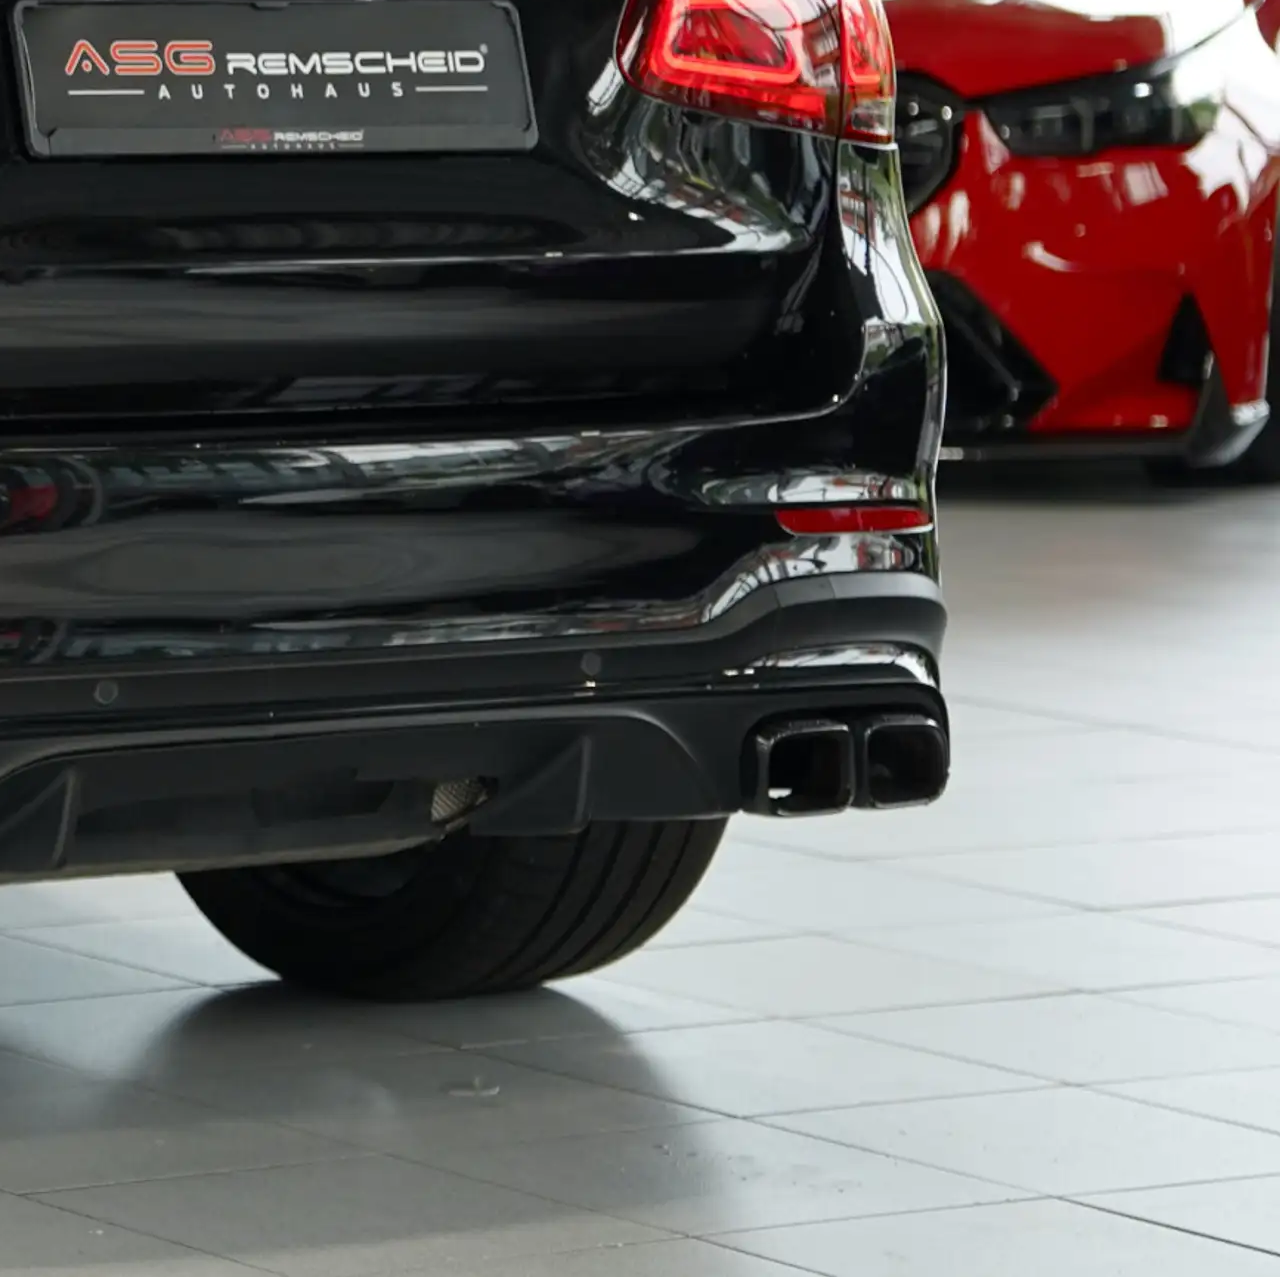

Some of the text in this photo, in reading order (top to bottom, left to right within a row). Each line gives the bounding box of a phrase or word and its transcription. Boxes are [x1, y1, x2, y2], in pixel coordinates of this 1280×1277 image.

[64, 39, 486, 76] ASG REMSCHEID
[158, 81, 403, 100] AUTOHAUS
